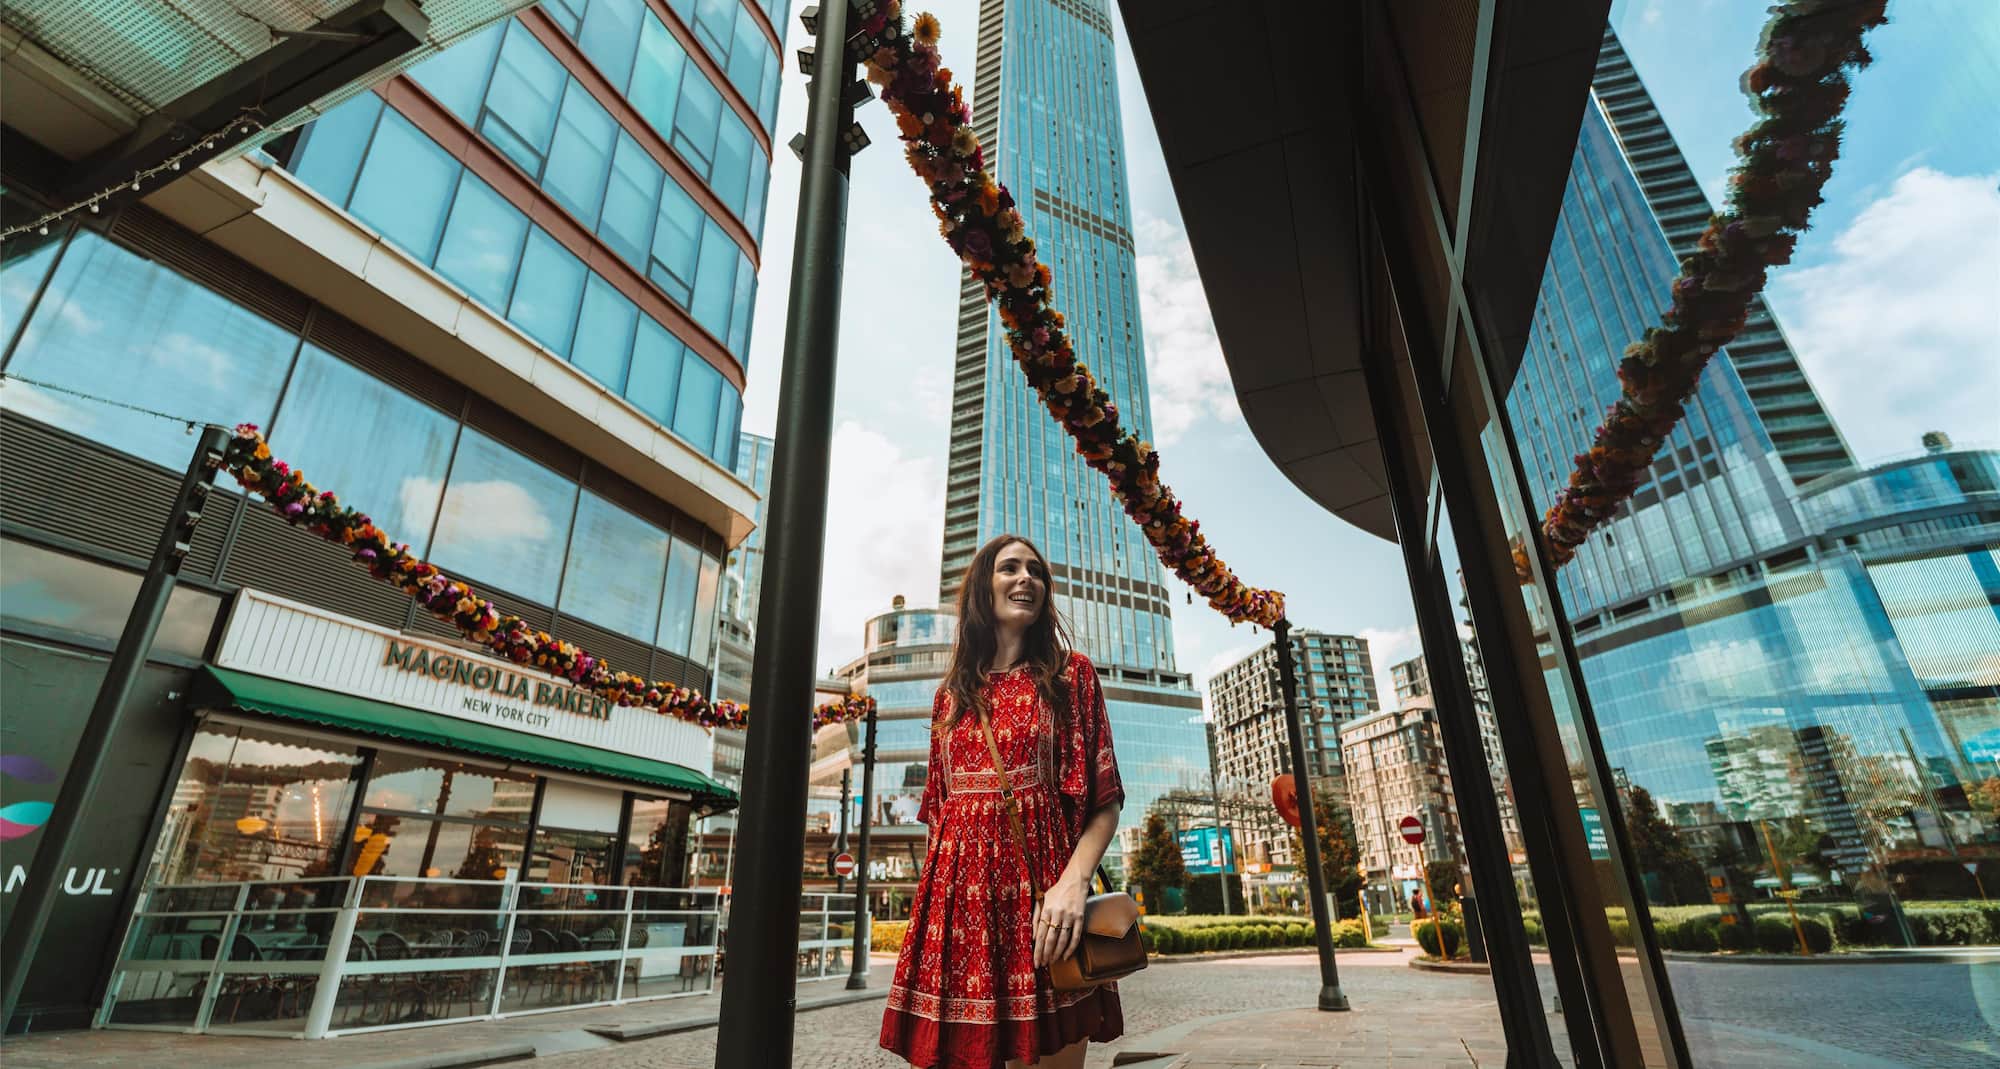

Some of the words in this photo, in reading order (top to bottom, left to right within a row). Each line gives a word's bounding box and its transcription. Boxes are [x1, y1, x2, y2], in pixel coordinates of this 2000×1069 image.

[384, 640, 529, 702] MAGNOLIA
[534, 682, 614, 721] BAKERY
[463, 697, 491, 715] NEW
[495, 704, 524, 723] YORK
[526, 711, 551, 729] CITY
